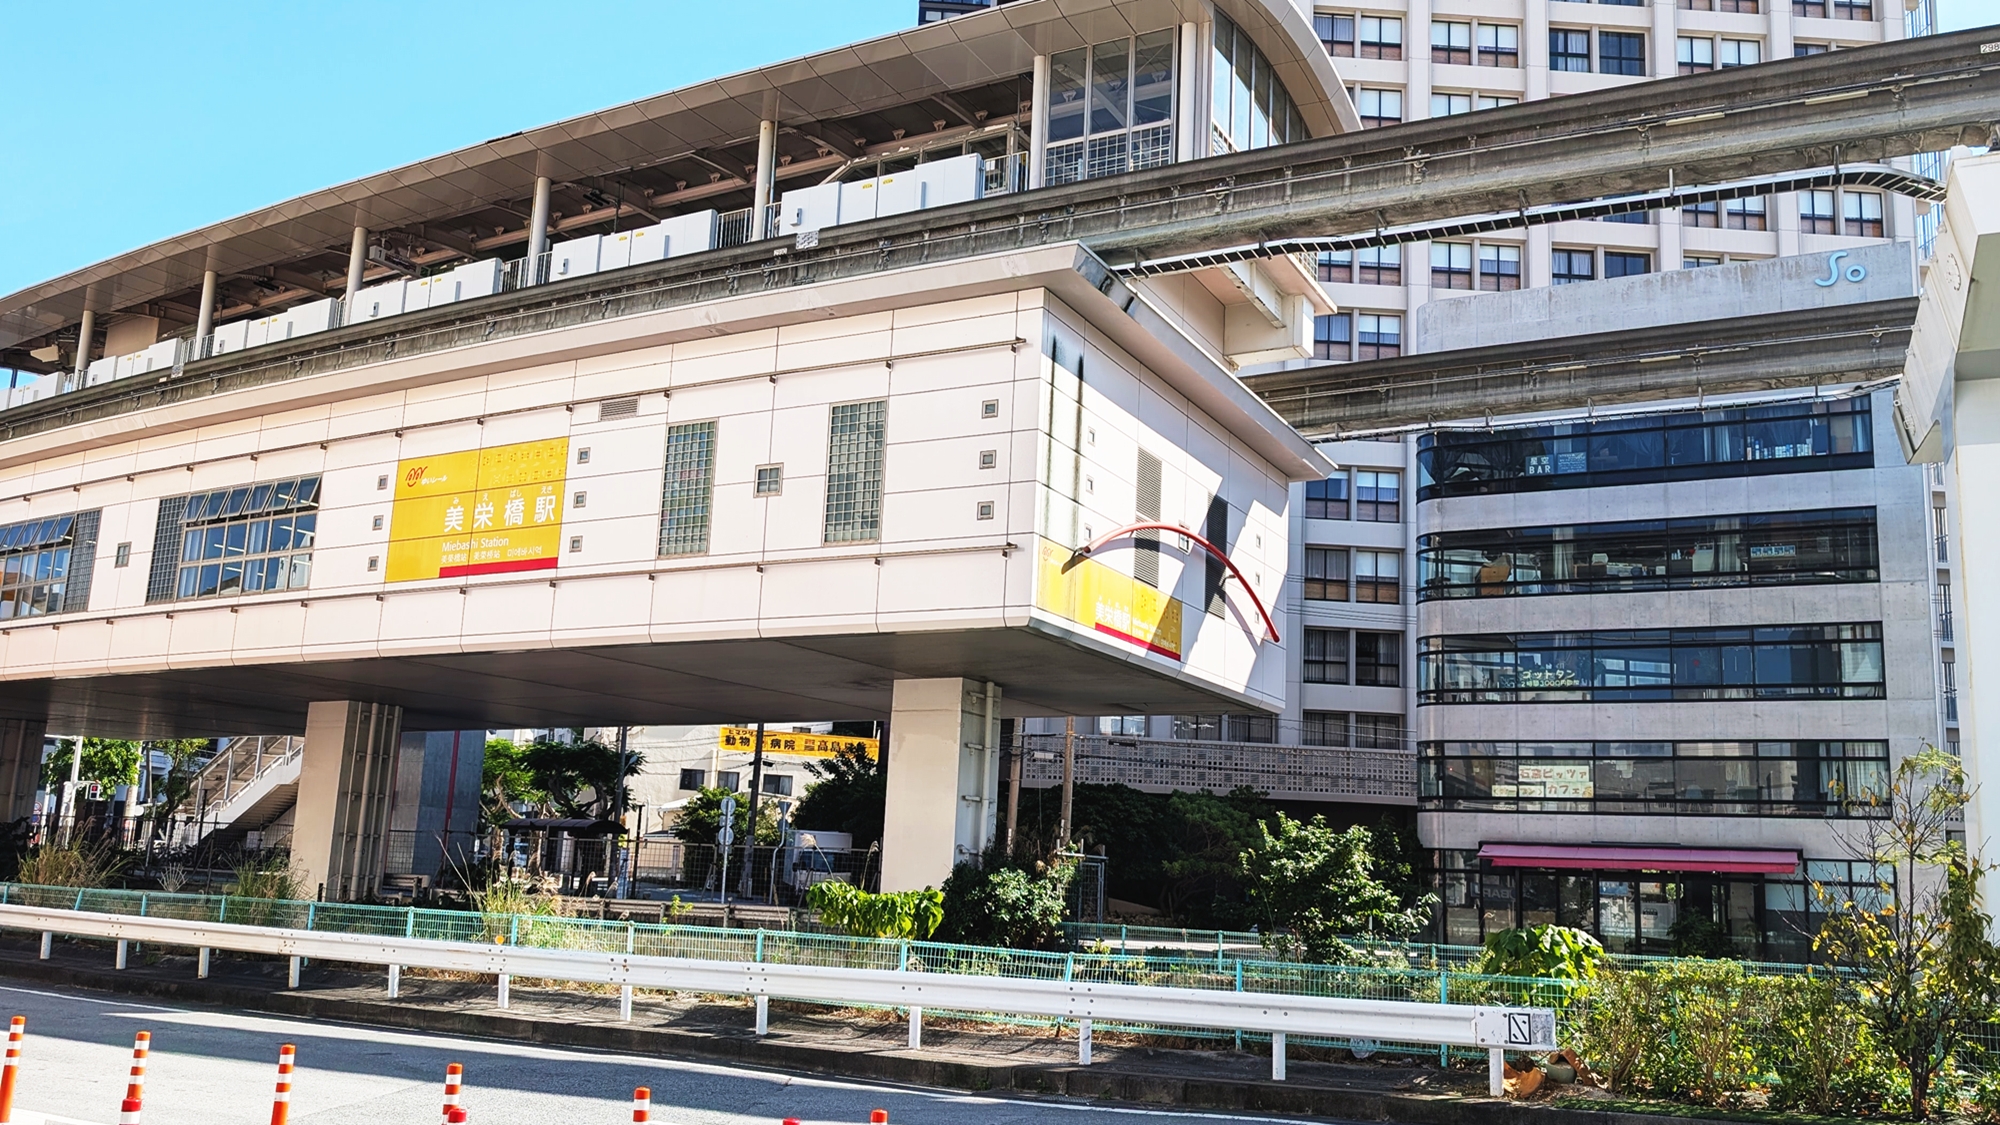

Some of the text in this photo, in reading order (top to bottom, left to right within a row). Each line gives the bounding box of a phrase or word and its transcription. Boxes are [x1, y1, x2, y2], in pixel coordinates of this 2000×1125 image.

[1814, 250, 1867, 287] So
[1529, 465, 1551, 474] BAR
[443, 495, 557, 533] 美栄橋駅
[441, 536, 509, 553] Miebashi Station
[1522, 669, 1576, 679] ゴットタン
[725, 735, 751, 747] 動物
[770, 738, 796, 750] 病院
[1547, 784, 1580, 795] カフェ
